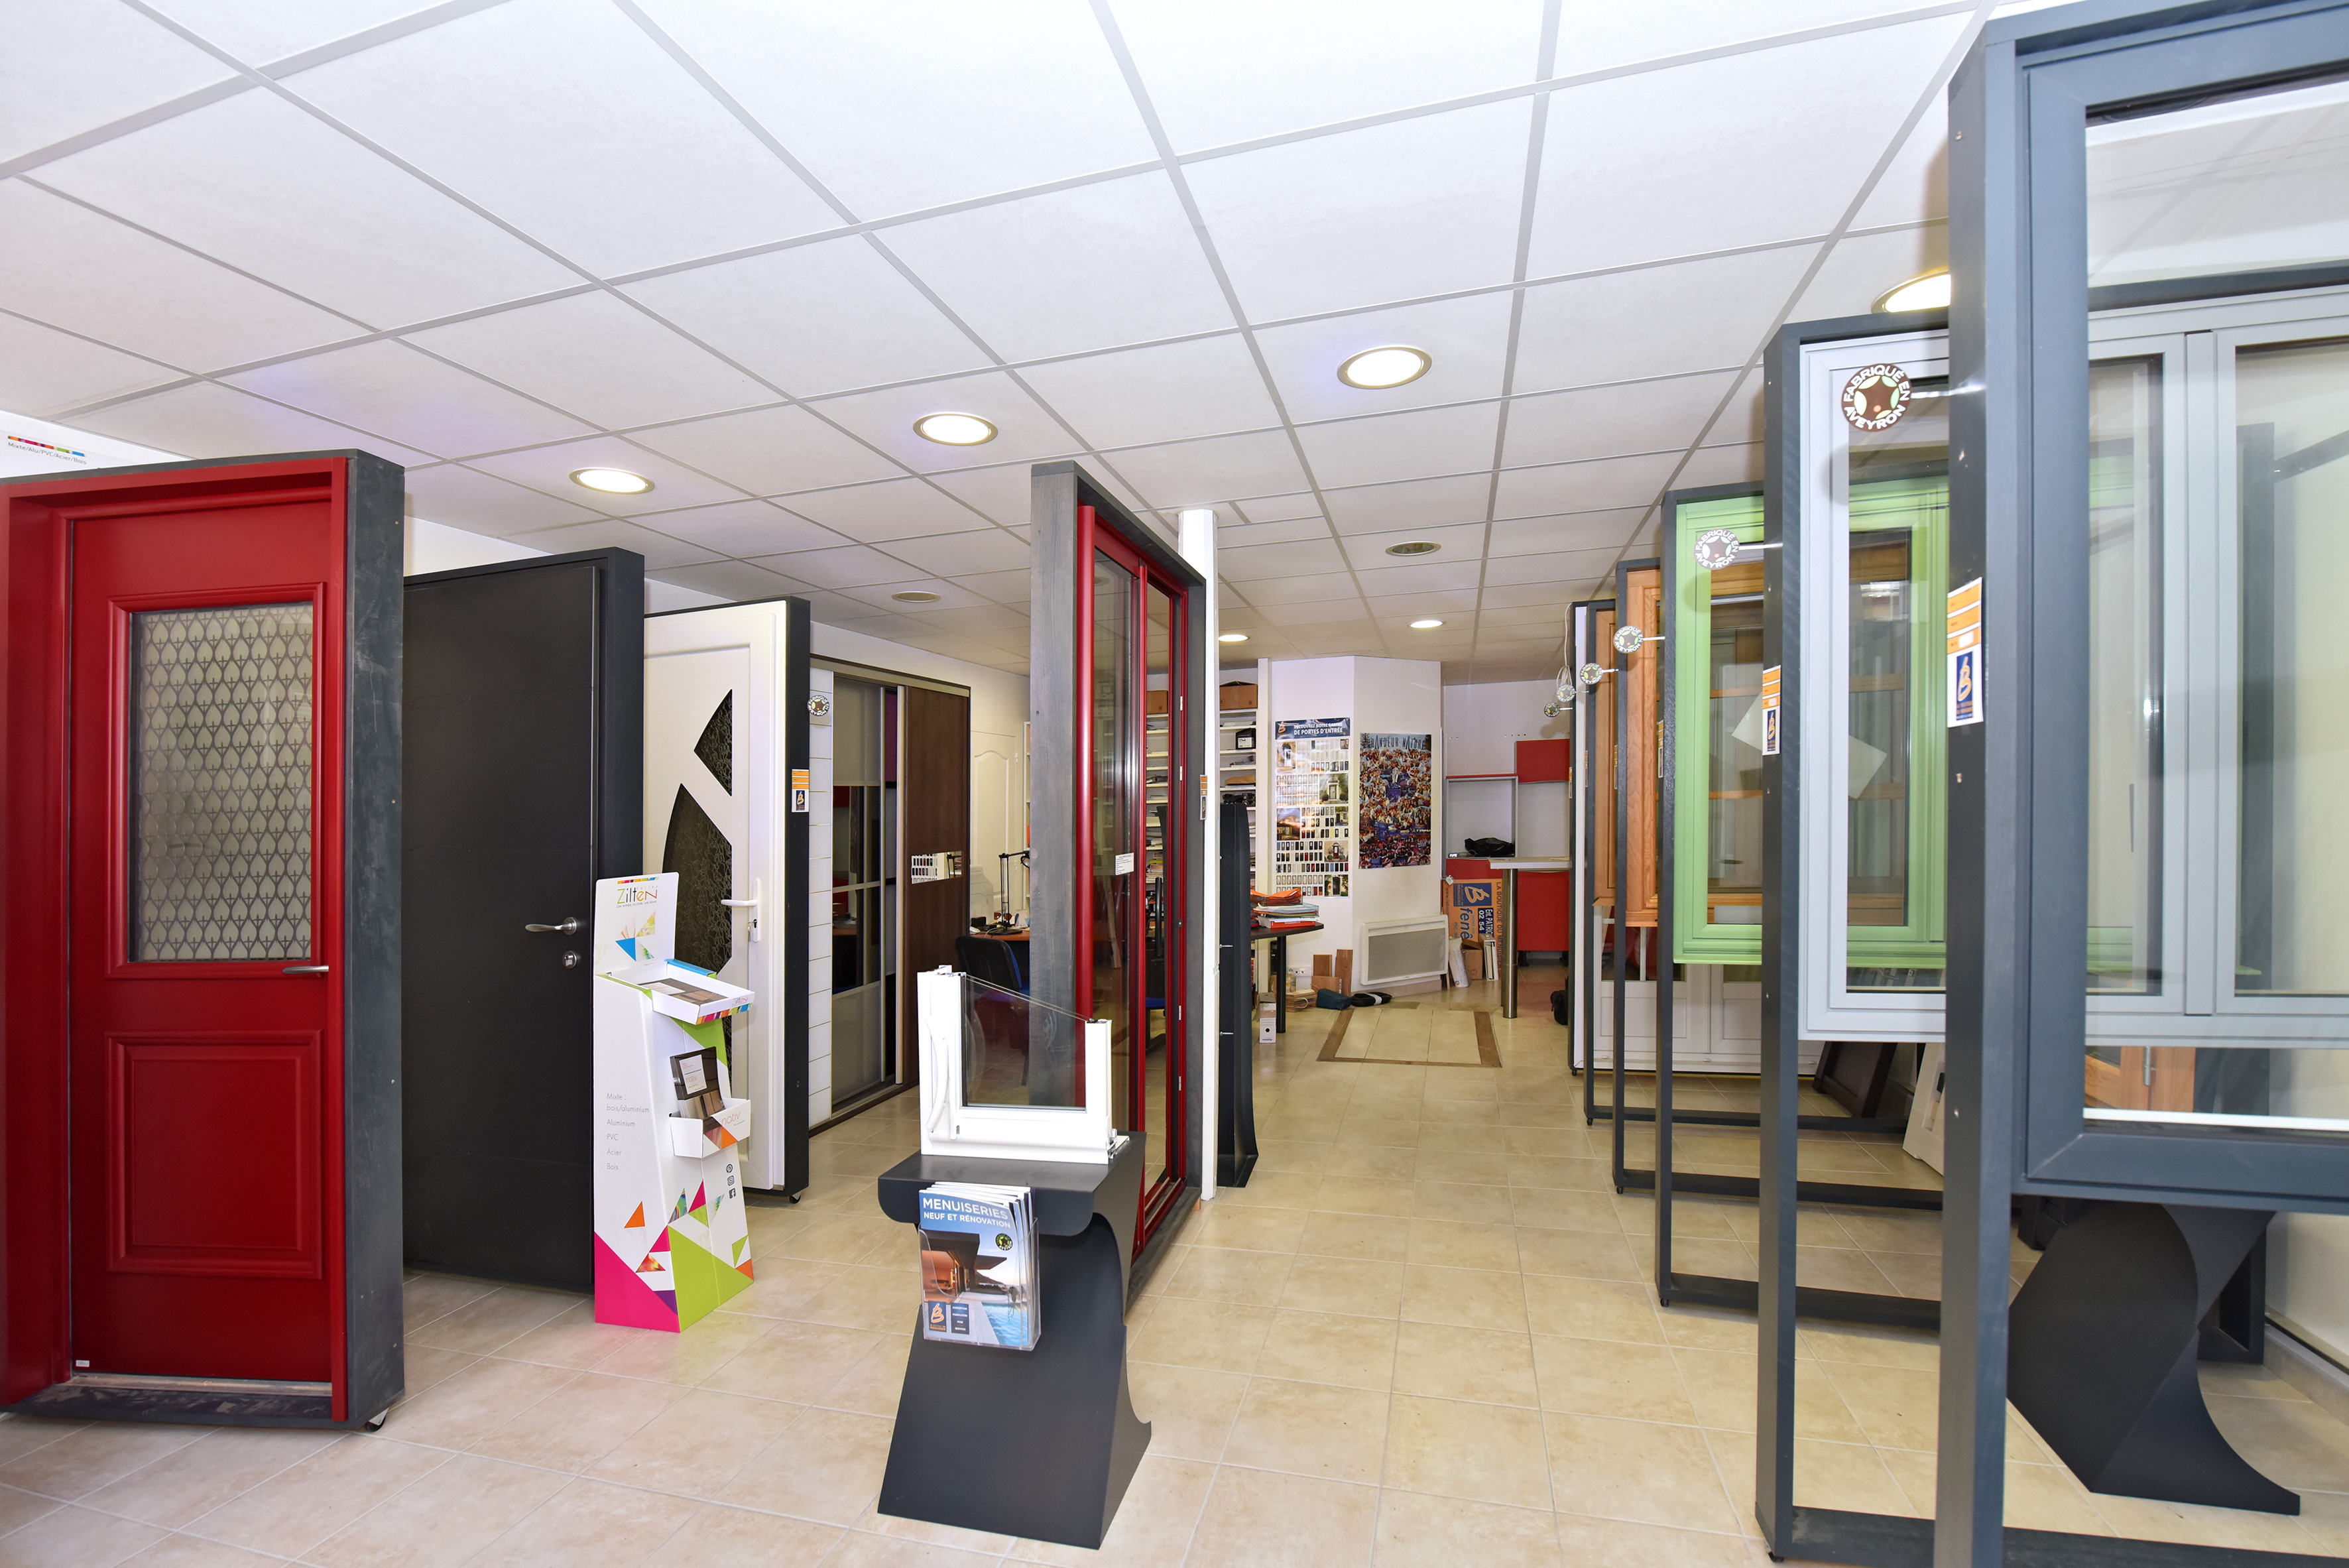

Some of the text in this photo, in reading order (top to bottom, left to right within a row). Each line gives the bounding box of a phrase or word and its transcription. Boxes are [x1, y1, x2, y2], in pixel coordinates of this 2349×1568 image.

[1843, 365, 1911, 402] FABRIQUÉ EN
[1844, 404, 1906, 430] AVEYRON
[8, 442, 87, 464] Mixte/Alu/PVC/Acier/Bois
[1695, 529, 1740, 552] FABRIQUÉ EN
[1695, 554, 1736, 568] AVEYRON
[1614, 642, 1641, 652] AVEYRON
[1479, 910, 1484, 931] 02 54
[607, 1104, 650, 1113] bois/aluminium
[923, 1197, 1008, 1219] MENUISERIES
[959, 1214, 1010, 1228] RÉNOVATION
